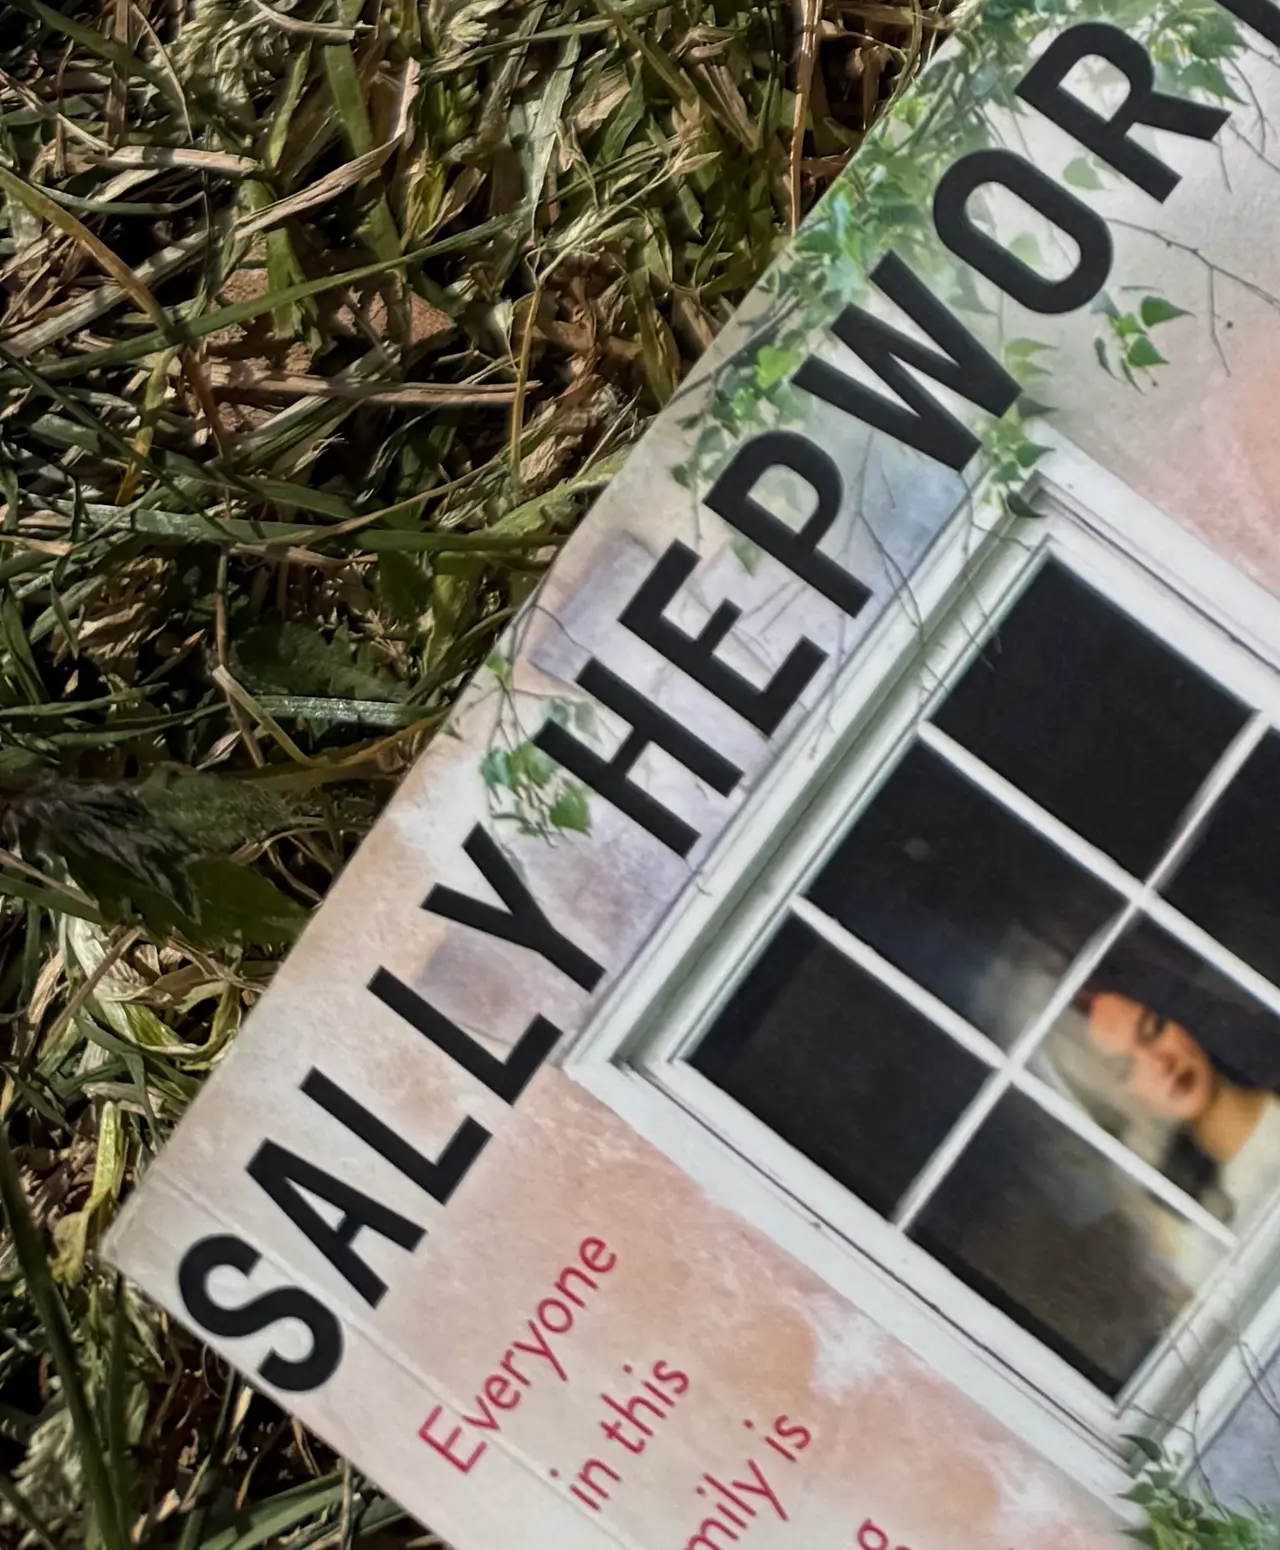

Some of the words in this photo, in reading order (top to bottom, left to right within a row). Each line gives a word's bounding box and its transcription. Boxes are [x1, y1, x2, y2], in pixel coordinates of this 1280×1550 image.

[177, 821, 606, 1394] SALLY
[418, 1235, 617, 1475] Everyone
[549, 1456, 621, 1512] in
[599, 1358, 690, 1456] this
[744, 1414, 812, 1463] is
